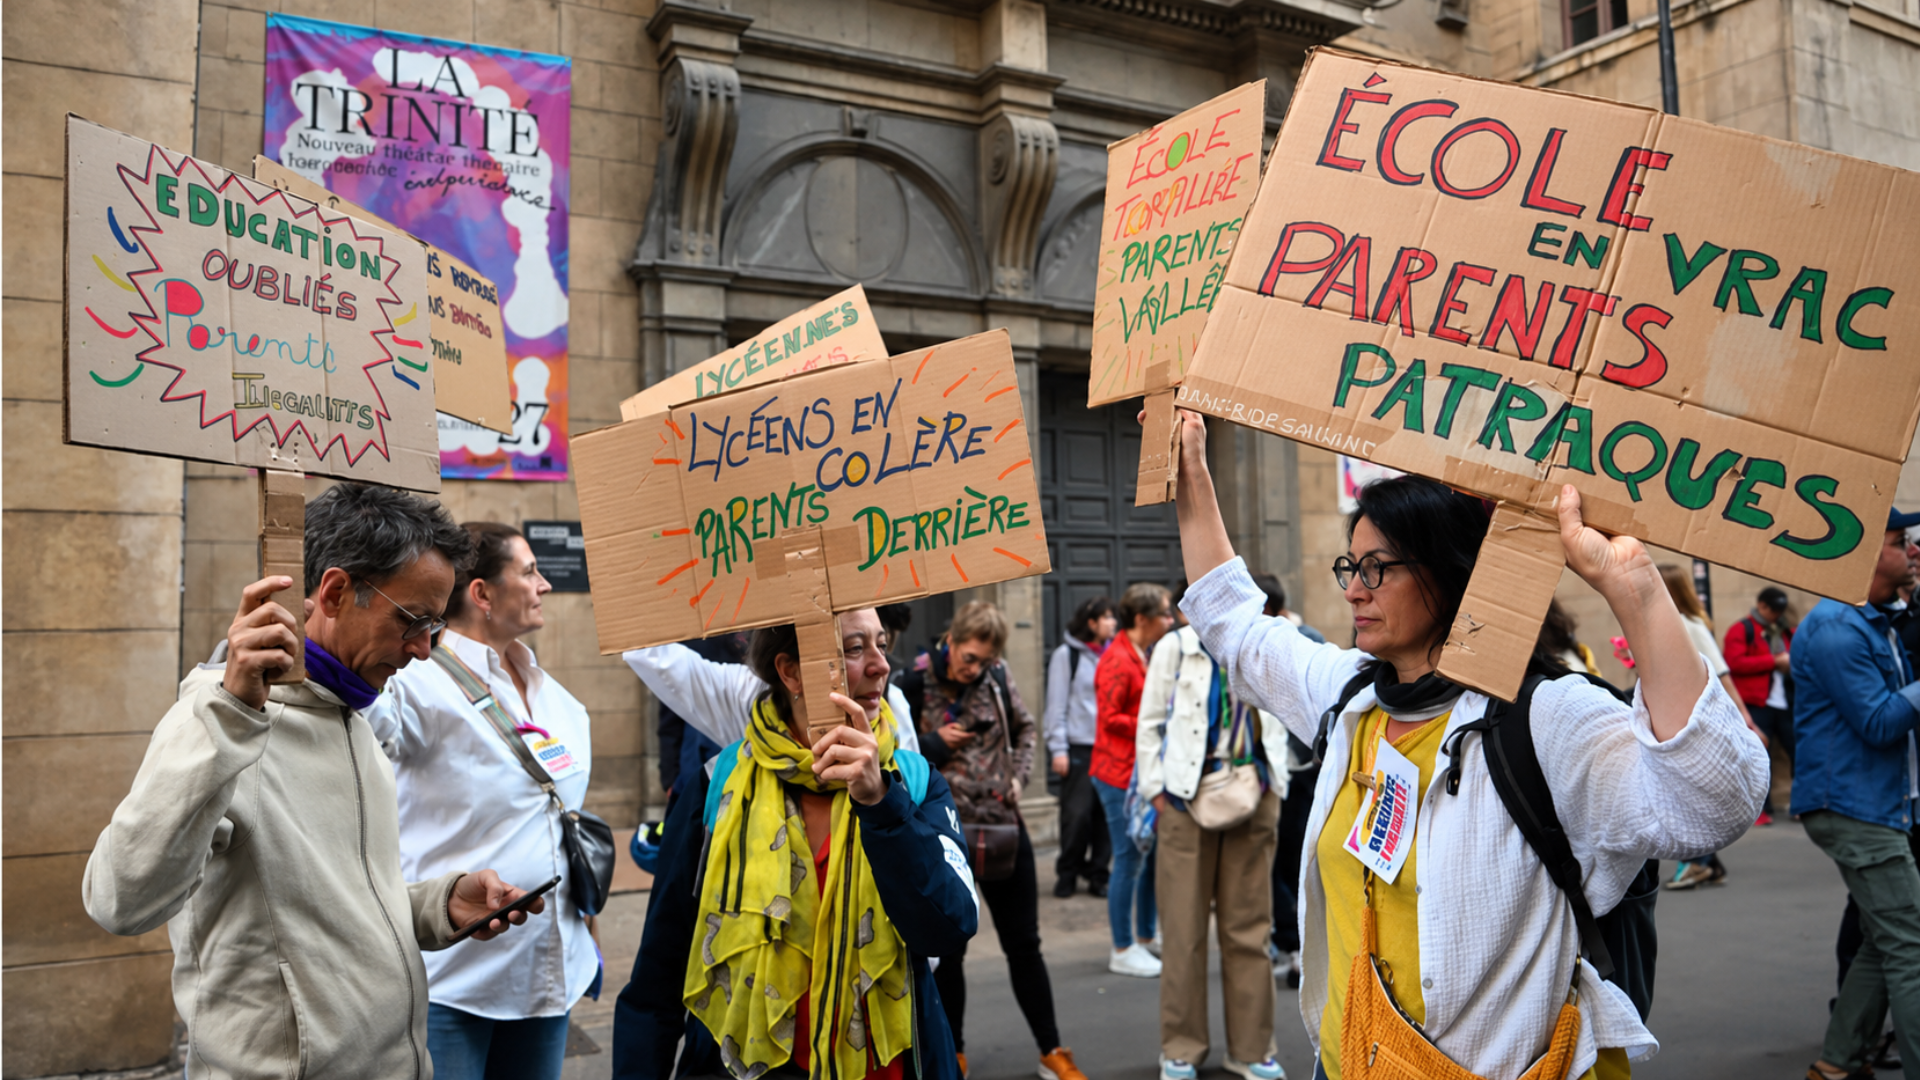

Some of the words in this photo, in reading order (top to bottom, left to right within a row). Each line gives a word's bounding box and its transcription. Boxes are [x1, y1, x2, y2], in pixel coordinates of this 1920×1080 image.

[386, 48, 470, 99] LA
[298, 132, 375, 156] Nouveau
[1126, 108, 1241, 190] ÉCOLE
[1315, 72, 1673, 231] ÉCOLE
[156, 173, 381, 281] EDUCATION
[202, 248, 357, 321] OUBLIÉS
[1257, 221, 1673, 389] PARENTS
[1526, 222, 1610, 269] EN
[1663, 233, 1895, 351] VRAC
[688, 396, 834, 482] LYCÉENS
[851, 378, 902, 434] EN
[816, 411, 992, 492] COLÈRE
[1331, 342, 1865, 560] PATRAQUES
[694, 482, 829, 578] PARENTS
[853, 486, 1031, 571] DERRIÈRE
